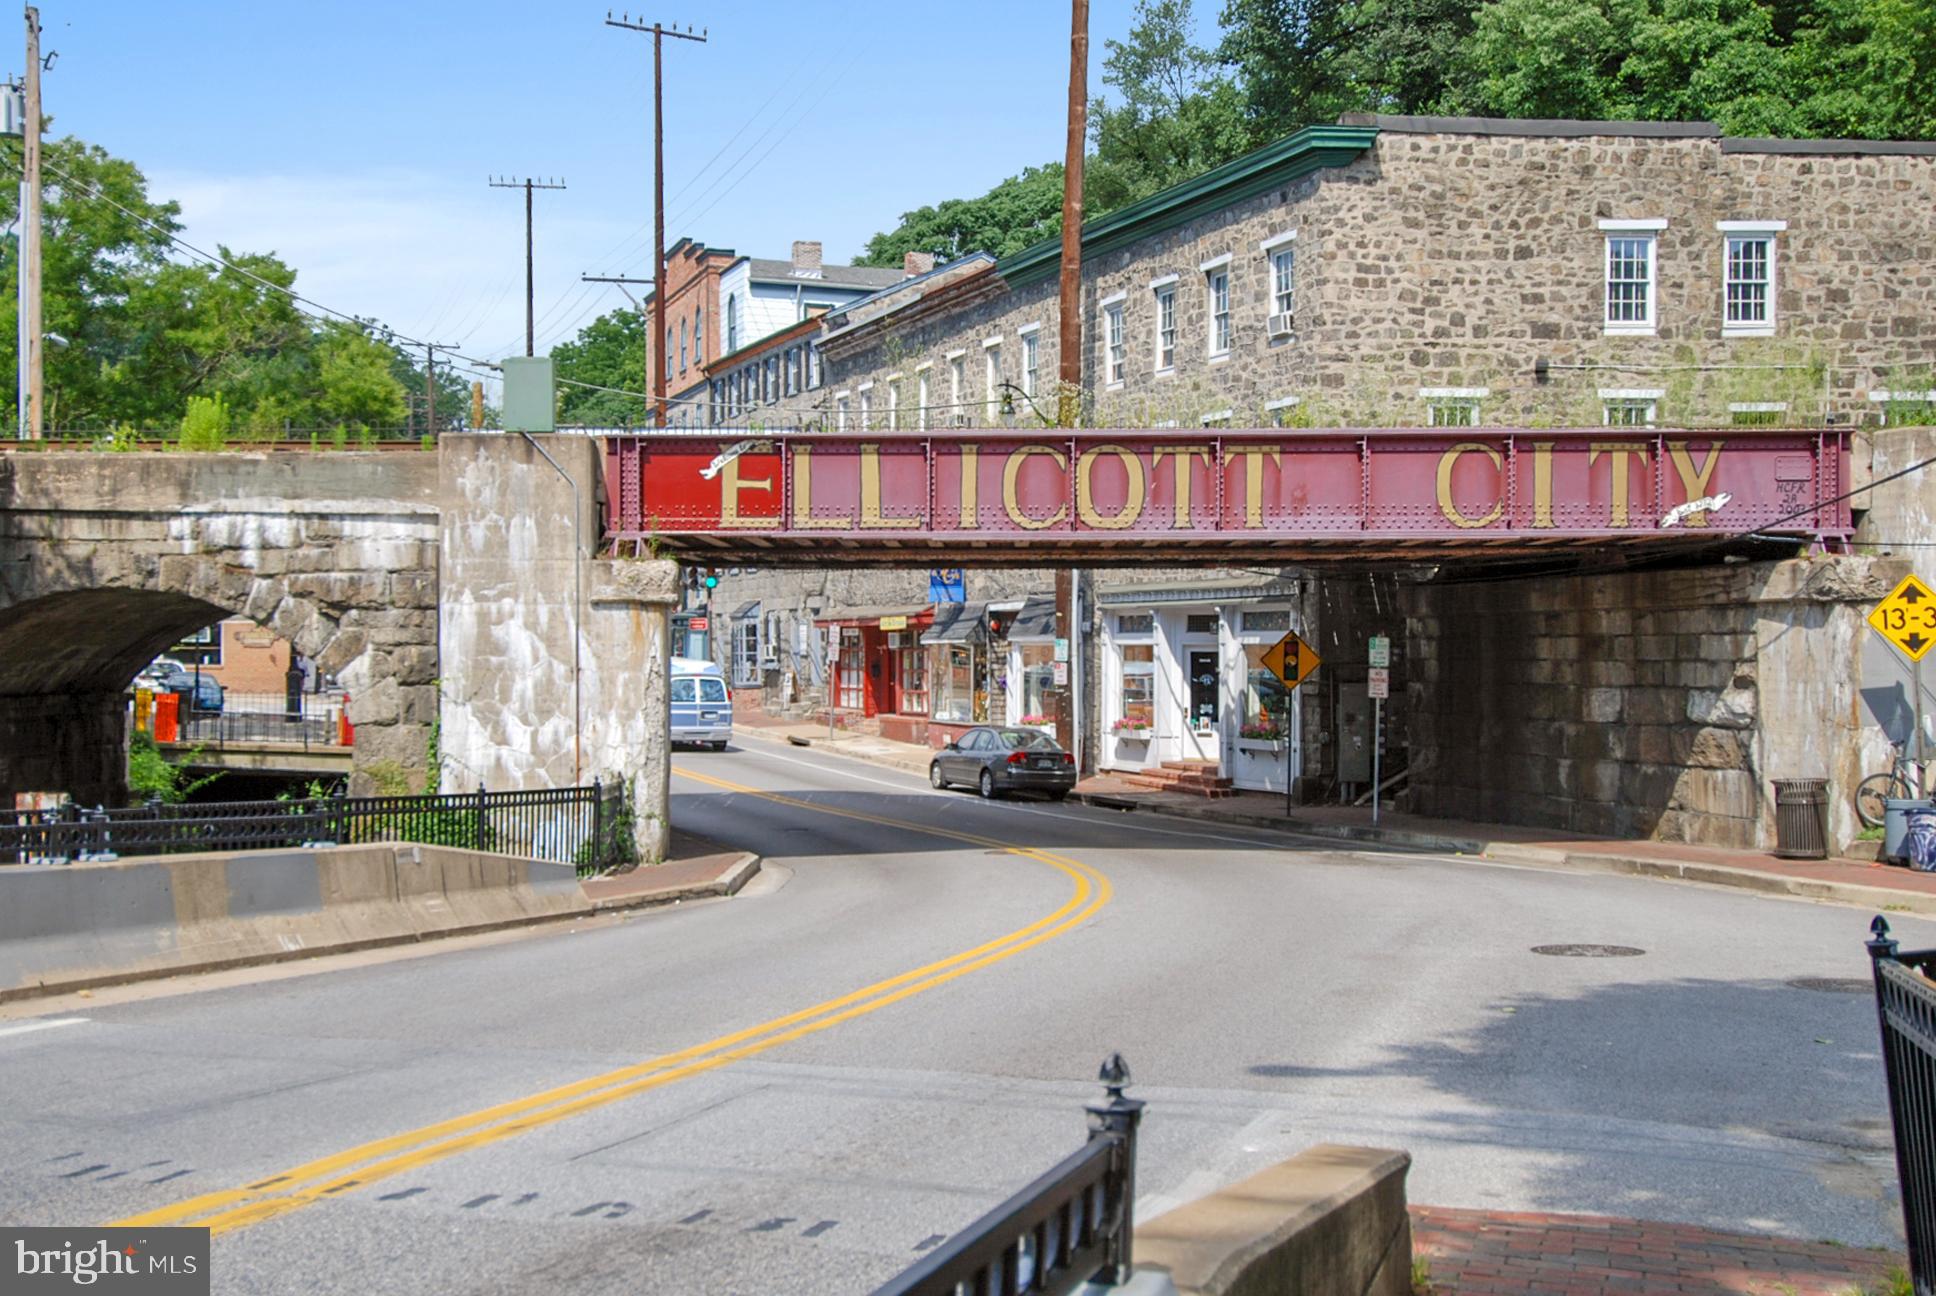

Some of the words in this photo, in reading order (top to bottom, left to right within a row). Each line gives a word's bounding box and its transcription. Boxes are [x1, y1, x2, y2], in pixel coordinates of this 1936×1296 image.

[718, 443, 1282, 530] ELLICOTT
[1435, 440, 1726, 530] CITY
[1776, 482, 1806, 494] HCFR
